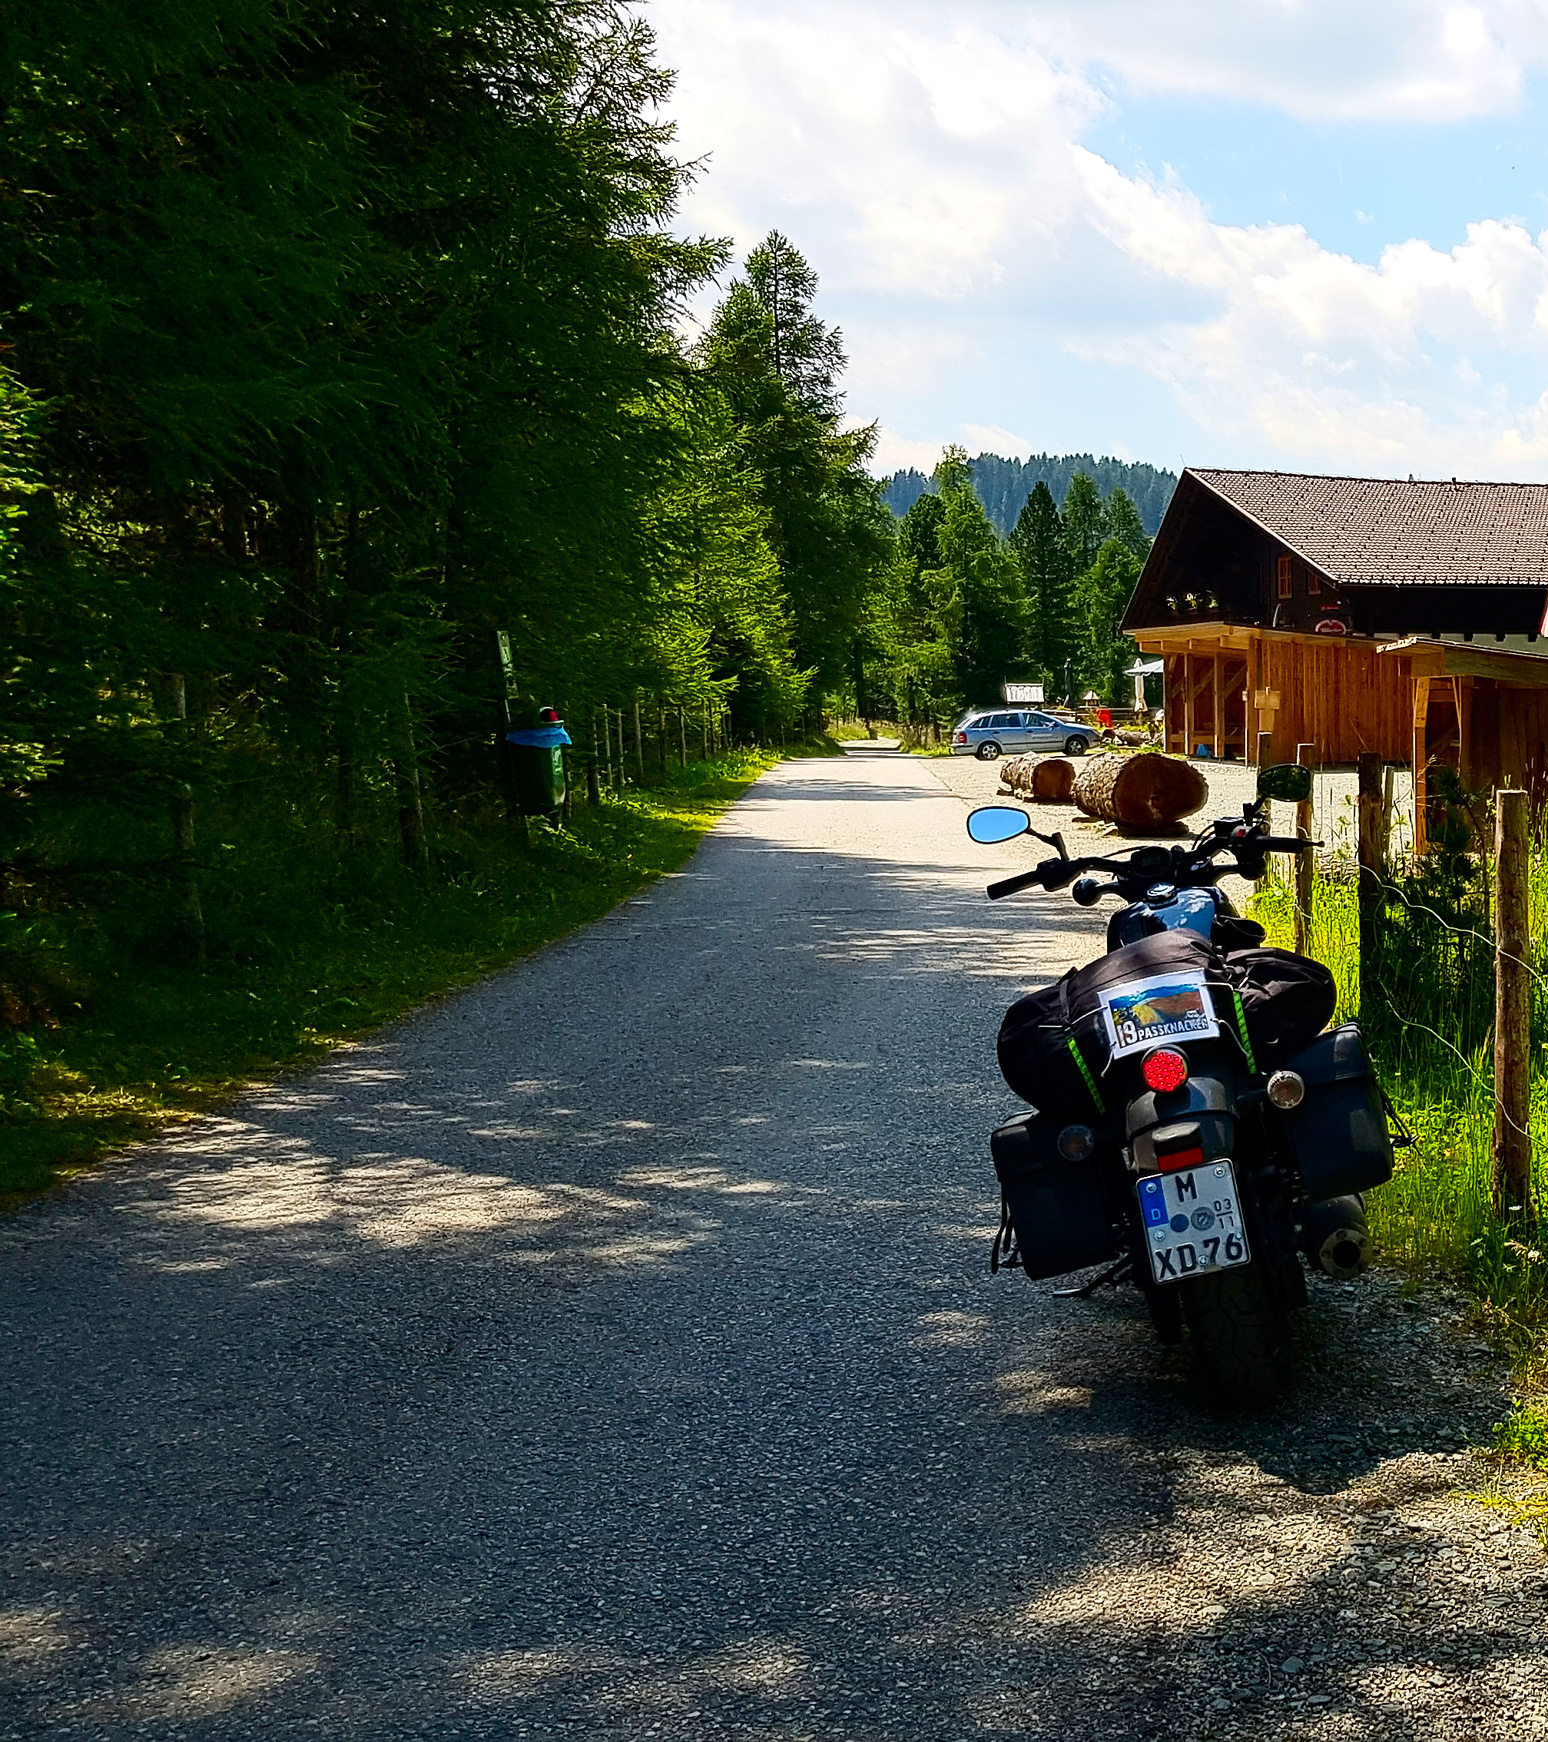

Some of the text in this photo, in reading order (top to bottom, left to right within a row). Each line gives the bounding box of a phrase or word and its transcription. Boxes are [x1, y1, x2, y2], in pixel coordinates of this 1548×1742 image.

[1138, 1018, 1210, 1041] PASSKNACKER
[1175, 1172, 1198, 1203] M
[1151, 1208, 1161, 1221] D
[1213, 1198, 1232, 1212] 03
[1155, 1232, 1243, 1279] XD 76
